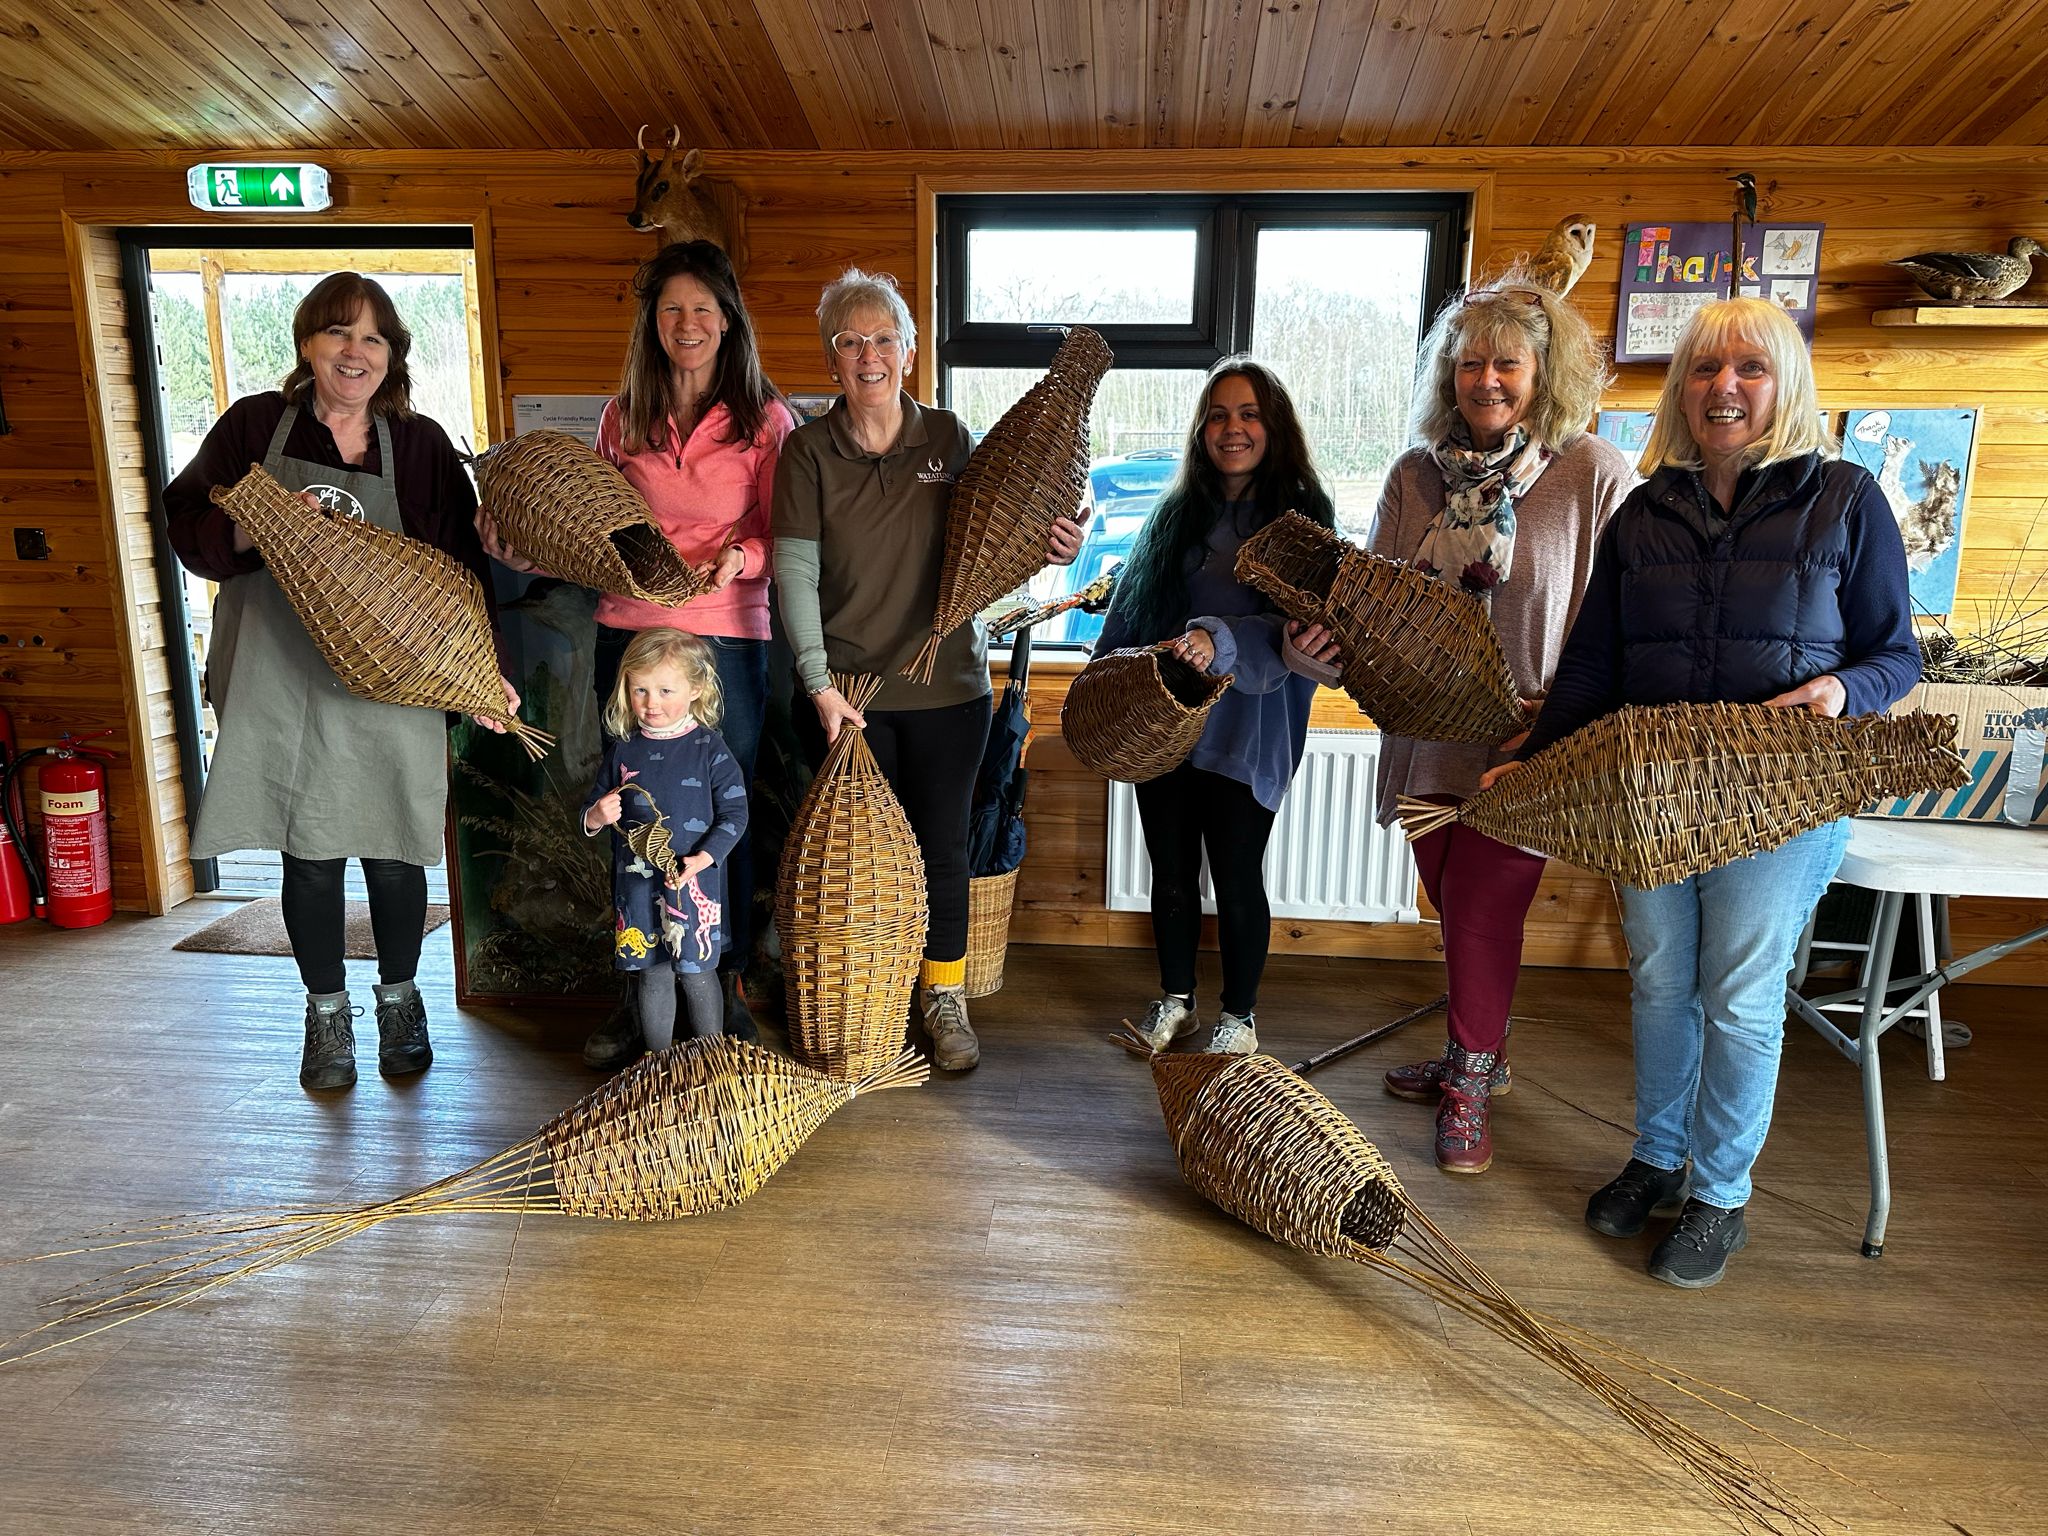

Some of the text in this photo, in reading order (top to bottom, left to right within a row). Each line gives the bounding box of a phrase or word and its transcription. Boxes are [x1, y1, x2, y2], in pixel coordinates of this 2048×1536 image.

[1857, 420, 1881, 434] Thank
[1872, 425, 1886, 437] you
[1984, 713, 2023, 727] TICO
[48, 799, 83, 809] Foam
